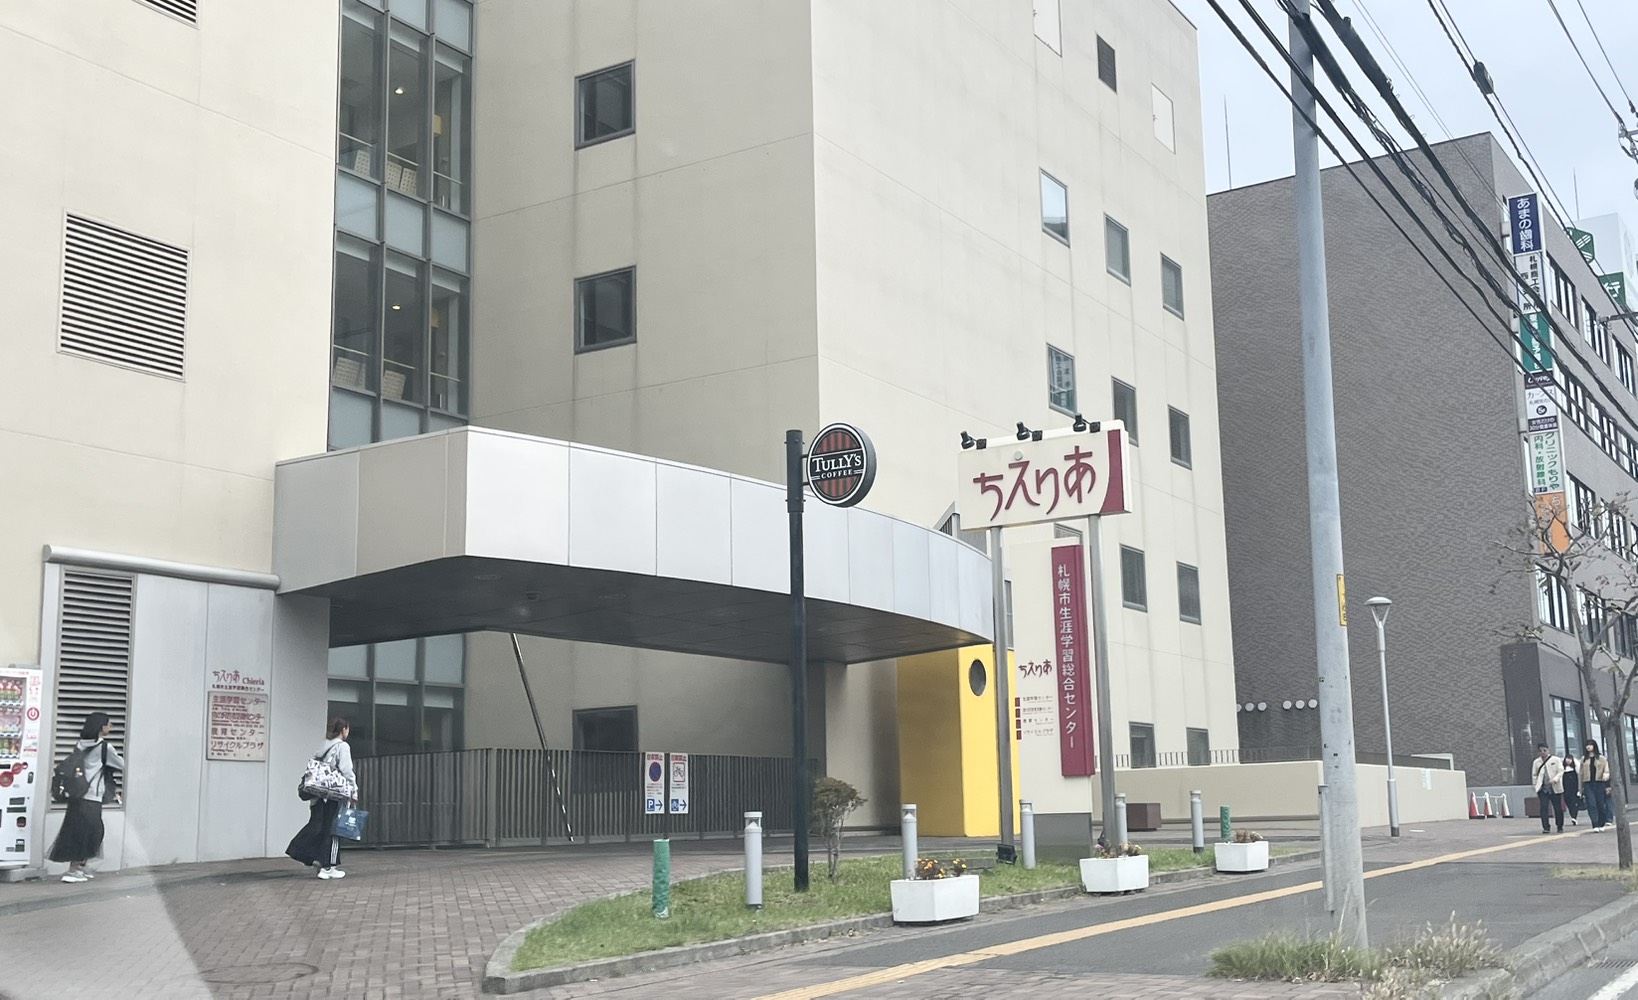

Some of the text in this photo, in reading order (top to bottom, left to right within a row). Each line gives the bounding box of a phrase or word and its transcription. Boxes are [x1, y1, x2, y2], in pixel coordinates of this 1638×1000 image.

[1517, 198, 1534, 251] あまの歯科
[821, 469, 852, 479] COFFEE
[973, 445, 1096, 521] ちえりあ
[1057, 564, 1076, 749] 札幌市生涯学習総合センター
[212, 670, 240, 684] ちえりあ
[1018, 659, 1052, 678] ちえりあ
[211, 741, 264, 749] リサイクルプラザ
